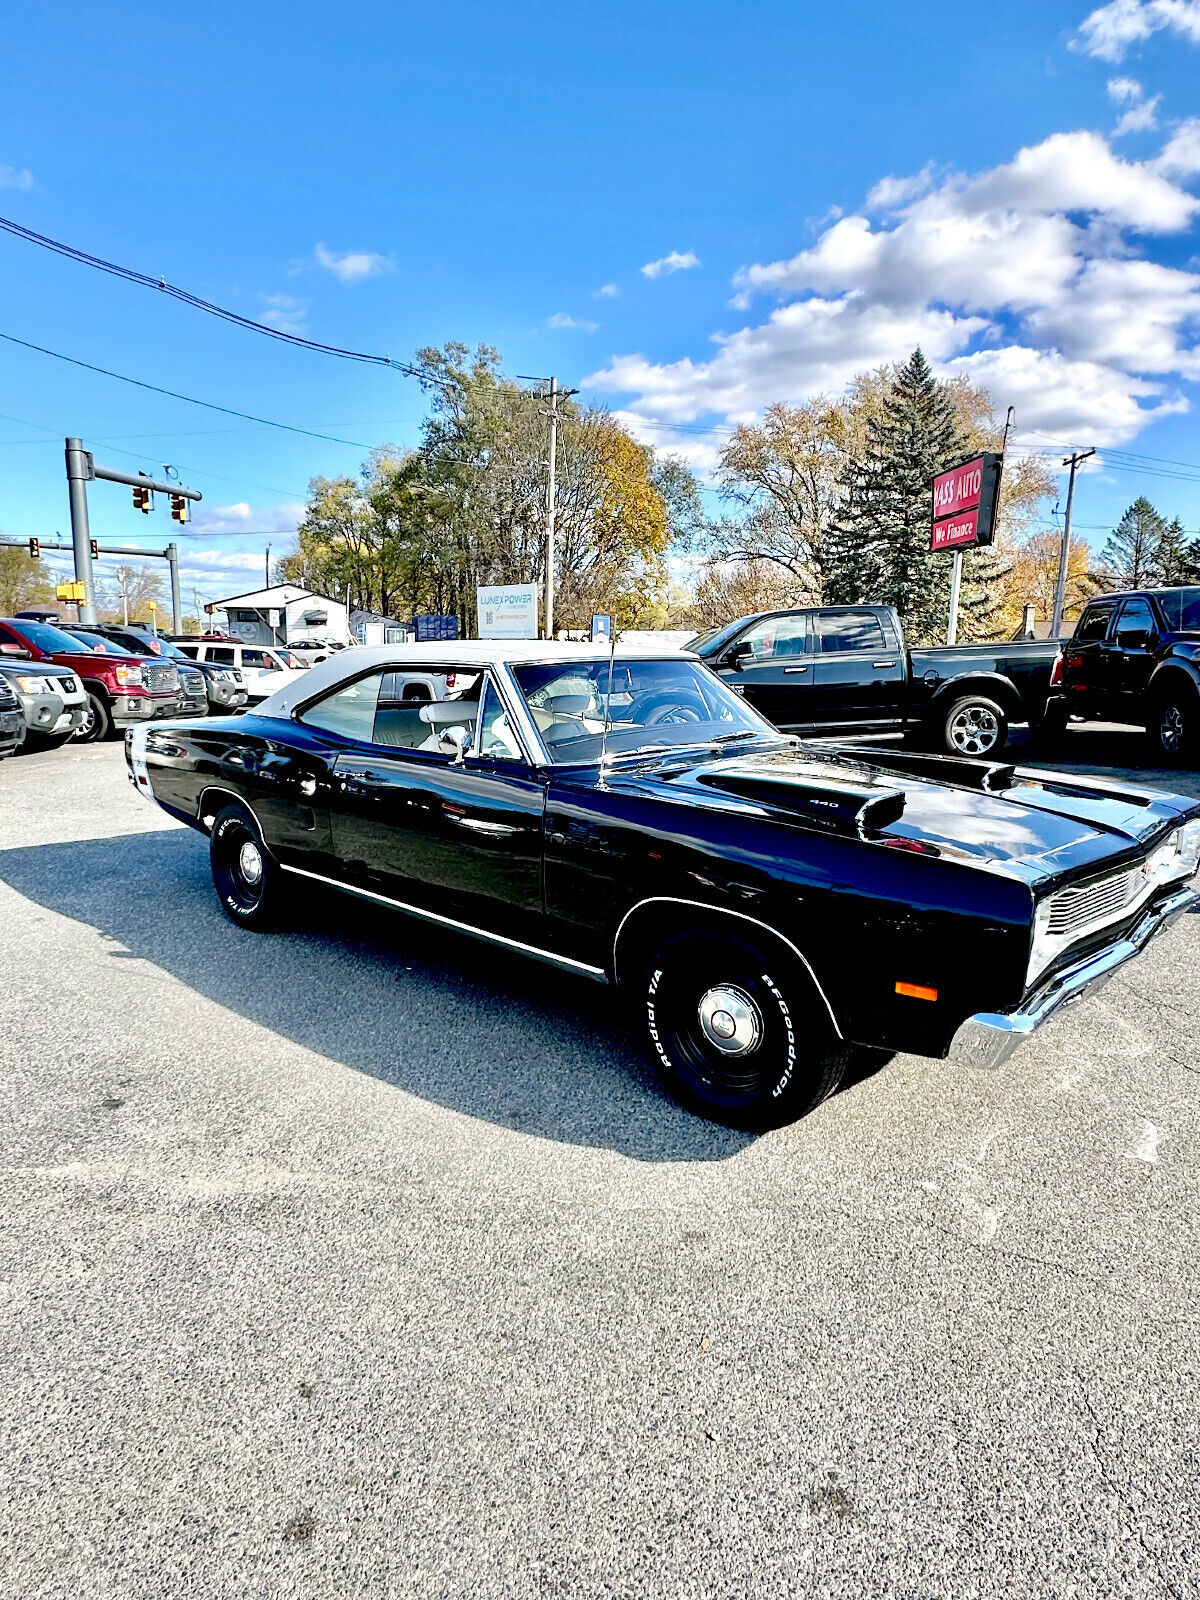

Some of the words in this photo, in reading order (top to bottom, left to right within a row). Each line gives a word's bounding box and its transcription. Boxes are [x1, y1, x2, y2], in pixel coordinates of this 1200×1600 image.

[956, 469, 982, 501] AUTO
[935, 527, 946, 543] We
[947, 522, 973, 541] Finance
[809, 799, 839, 808] 440
[648, 969, 663, 995] T/A
[647, 1002, 672, 1067] Radial
[761, 974, 796, 1098] BFGoodrich
